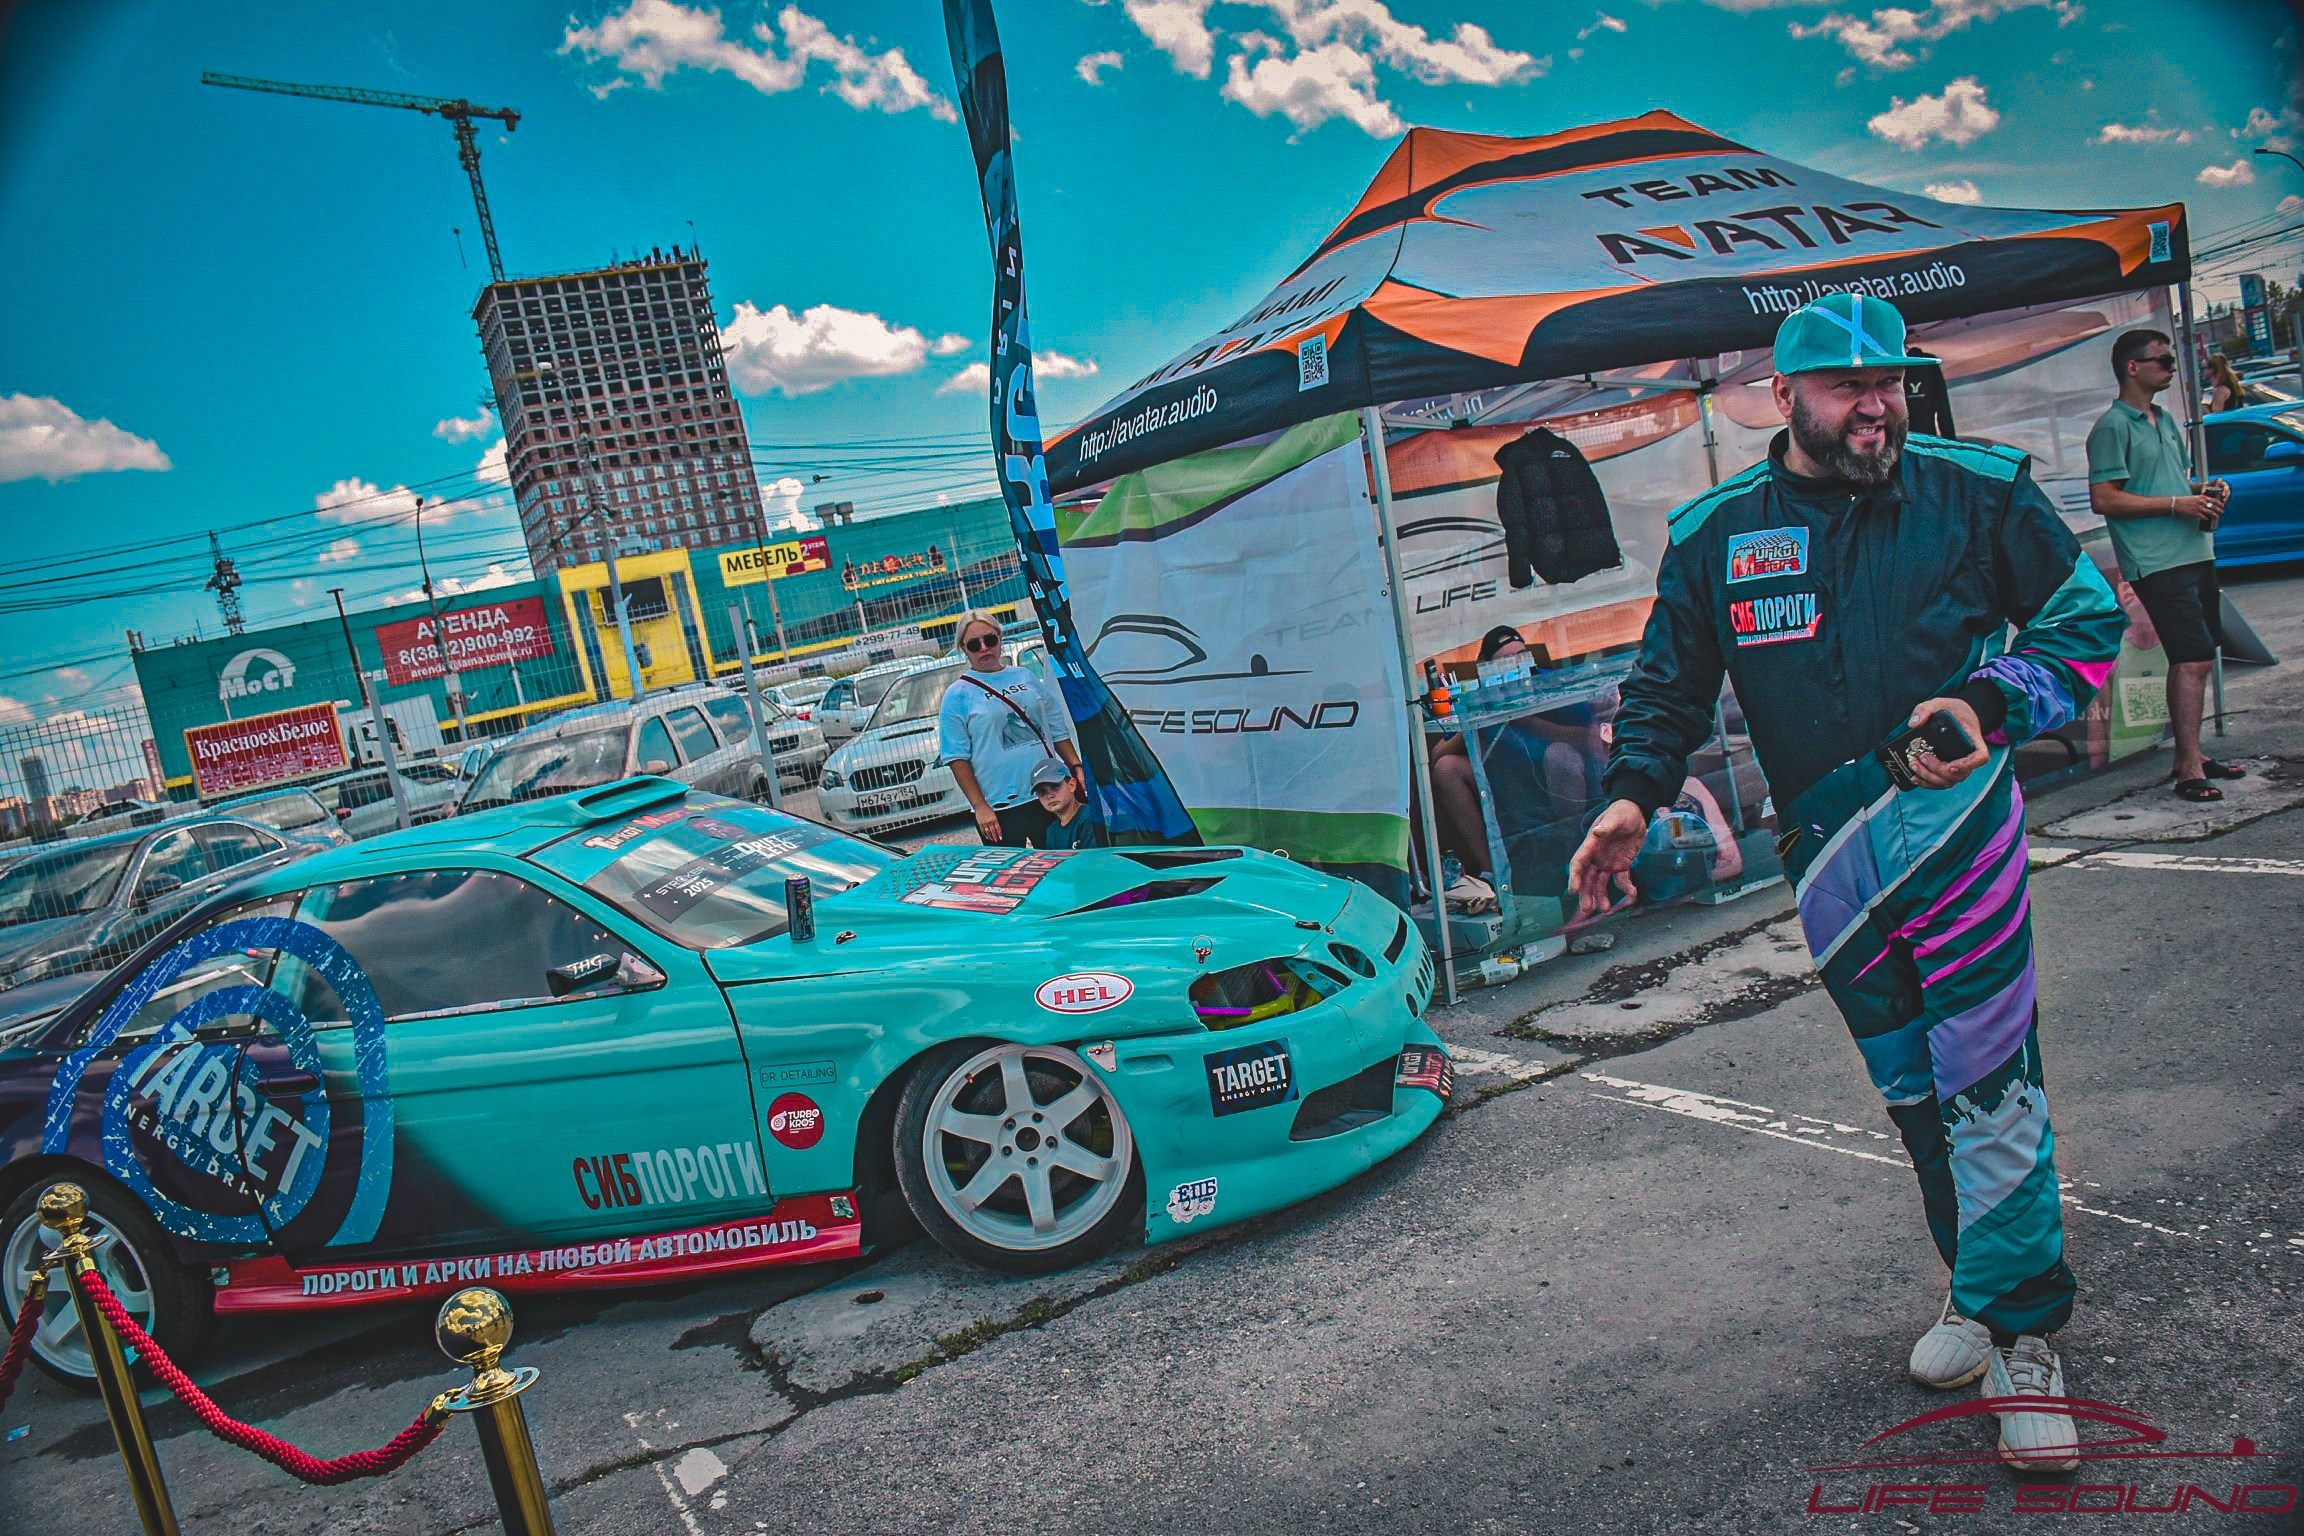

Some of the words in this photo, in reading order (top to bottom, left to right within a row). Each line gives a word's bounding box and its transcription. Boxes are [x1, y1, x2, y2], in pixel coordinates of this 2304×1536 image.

[1581, 168, 1797, 208] TEAM
[1597, 203, 1943, 264] AVATAR
[1079, 384, 1218, 462] http://avatar.audio
[727, 547, 798, 573] МЕБЕЛЬ
[1416, 580, 1497, 614] LIFE
[1730, 593, 1816, 633] СИБПОРОГИ
[863, 626, 921, 646] 299-77-49
[984, 683, 1028, 700] PASE
[1191, 702, 1360, 733] SOUND
[196, 719, 330, 762] Красное&Белое
[683, 877, 715, 898] 2025
[1052, 985, 1117, 1006] HEL
[780, 1066, 835, 1082] DETAILING
[1212, 1053, 1288, 1093] TARGET
[127, 1021, 323, 1196] TARGET
[1221, 1089, 1256, 1102] ENERGY
[1260, 1082, 1288, 1094] DRINK
[111, 1093, 197, 1159] ENERGY
[788, 1108, 820, 1119] TURBO
[789, 1118, 815, 1128] KROS
[572, 1141, 767, 1210] СИБПОРОГИ
[303, 1266, 396, 1296] ПОРОГИ
[402, 1264, 419, 1285] И
[424, 1257, 492, 1285] АРКИ
[498, 1249, 532, 1276] НА
[539, 1238, 633, 1272] ЛЮБОЙ
[638, 1219, 817, 1261] АВТОМОБИЛЬ
